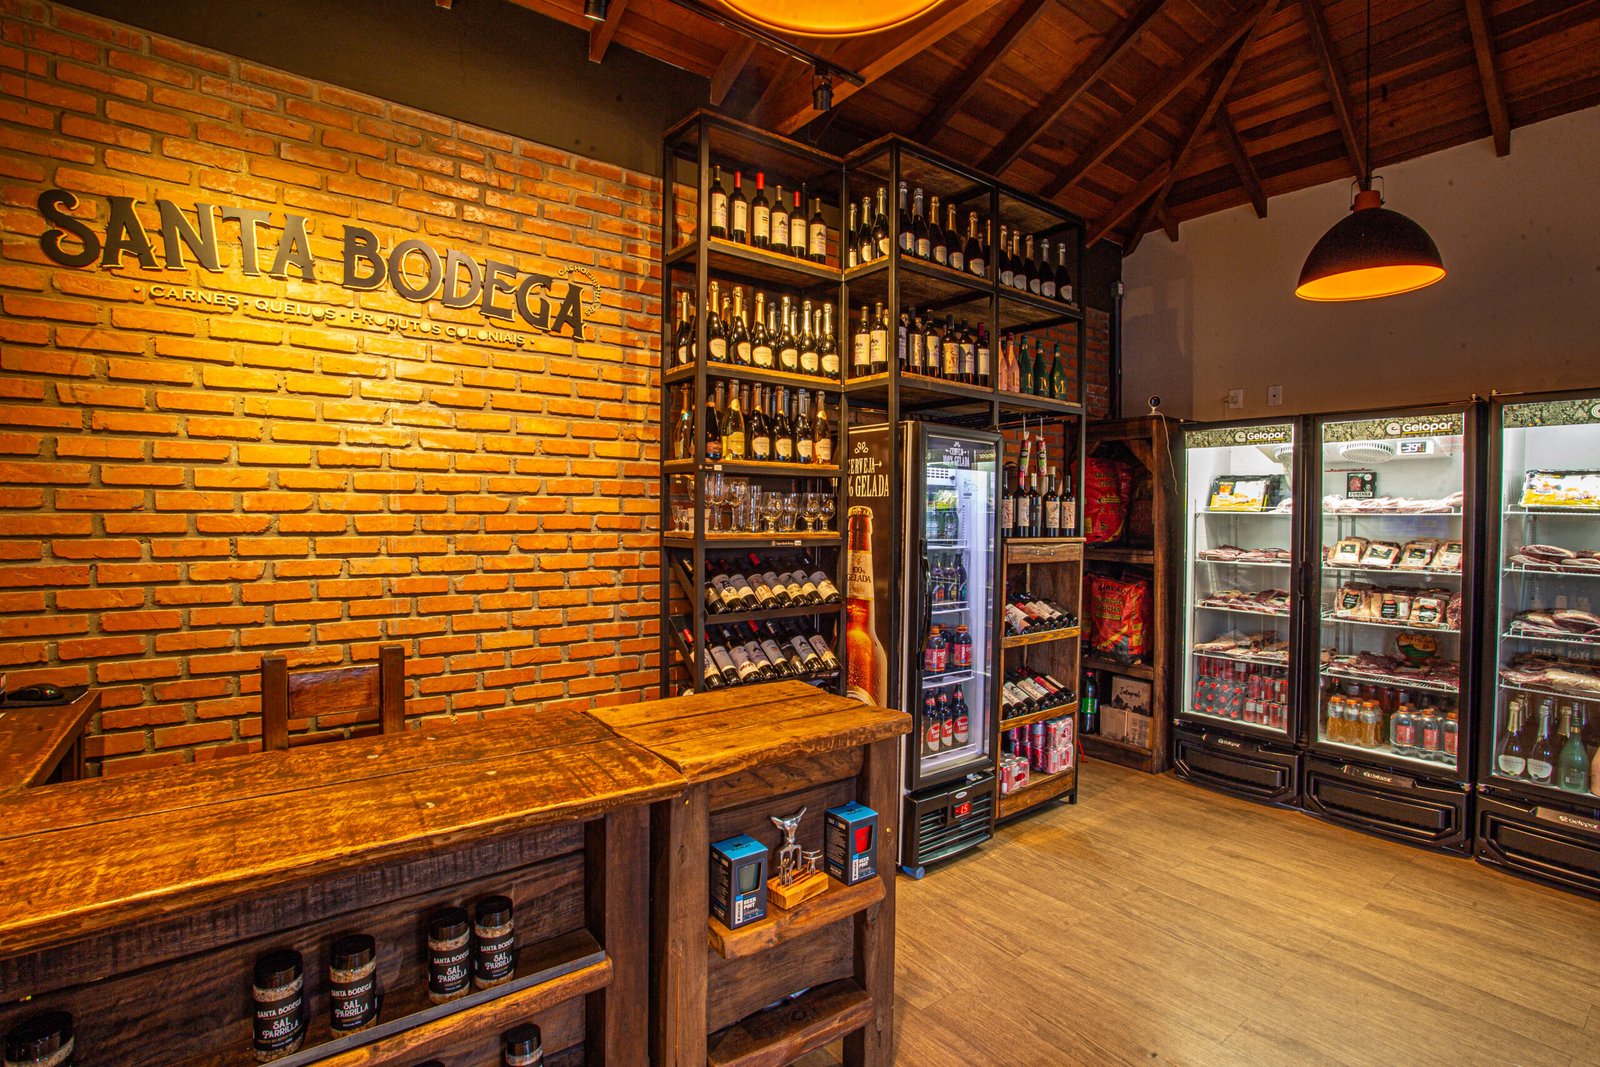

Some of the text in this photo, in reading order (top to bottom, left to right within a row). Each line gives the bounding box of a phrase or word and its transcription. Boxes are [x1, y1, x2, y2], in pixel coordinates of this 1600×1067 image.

[38, 189, 586, 341] SANTA BODEGA
[150, 285, 526, 344] CARNES QUEIJOS PRODUTOS COLONIAIS
[1402, 422, 1453, 433] Gelopar
[1247, 431, 1286, 441] Gelopar
[855, 474, 889, 497] GELADA
[485, 955, 513, 970] PARRILLA
[493, 952, 508, 962] SAL
[437, 968, 467, 983] PARRILLA
[446, 965, 461, 975] SAL
[335, 1003, 369, 1018] PARRILLA
[343, 999, 361, 1010] SAL
[262, 1019, 299, 1039] PARRILLA
[272, 1017, 291, 1030] SAL
